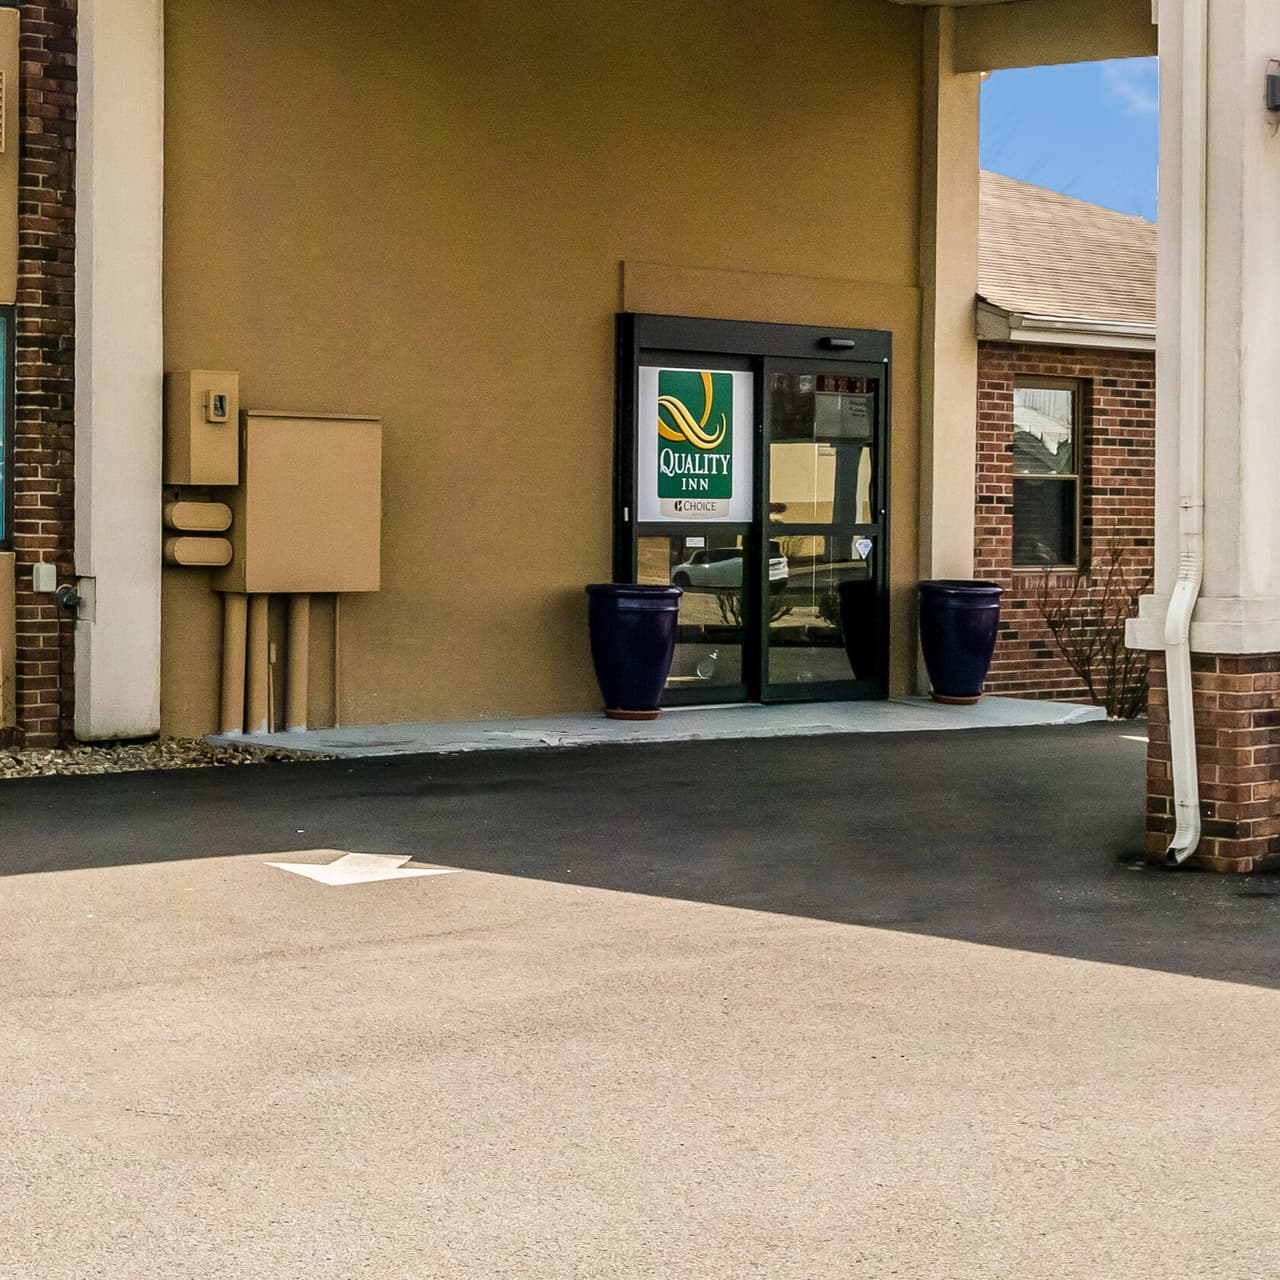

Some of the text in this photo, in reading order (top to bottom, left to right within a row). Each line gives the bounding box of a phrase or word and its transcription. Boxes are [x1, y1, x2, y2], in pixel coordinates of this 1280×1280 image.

[660, 448, 731, 477] QUALITY
[681, 478, 709, 490] INN
[683, 501, 716, 511] CHOICE
